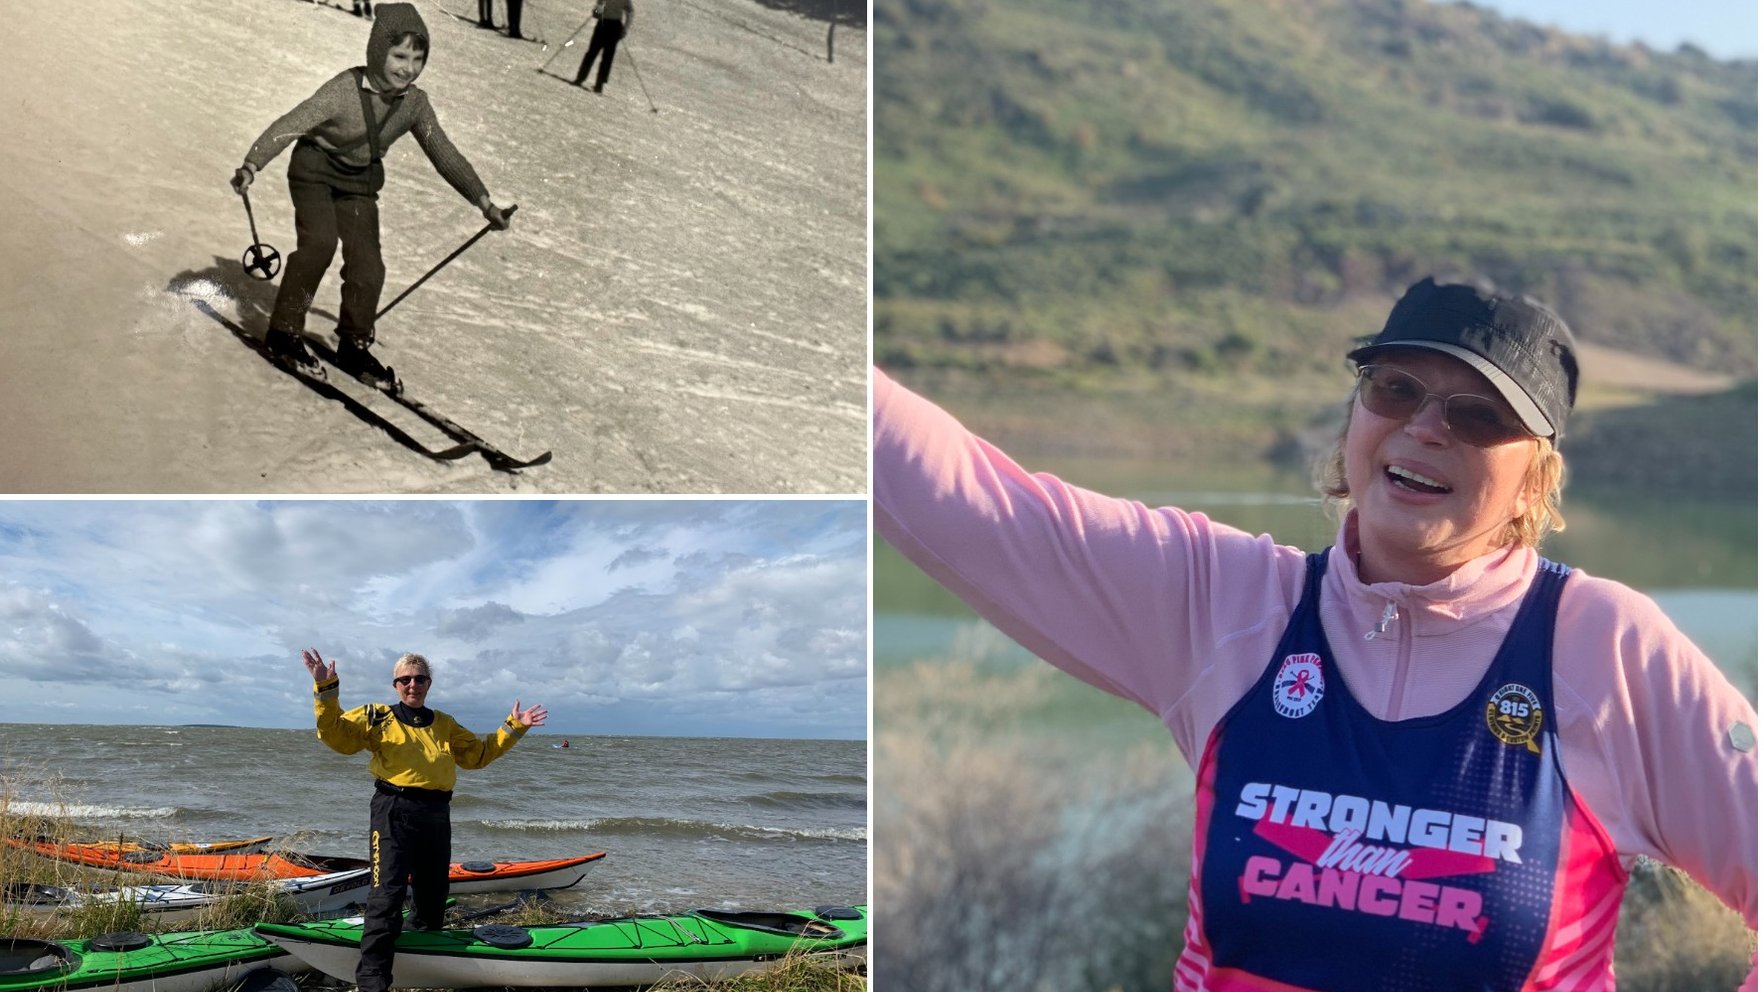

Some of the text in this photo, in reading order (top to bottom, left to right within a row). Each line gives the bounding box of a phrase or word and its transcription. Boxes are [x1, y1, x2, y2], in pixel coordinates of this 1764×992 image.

[1500, 699, 1529, 717] 815
[1235, 782, 1523, 865] STRONGER
[1316, 828, 1413, 878] than
[1243, 855, 1483, 933] CANCER
